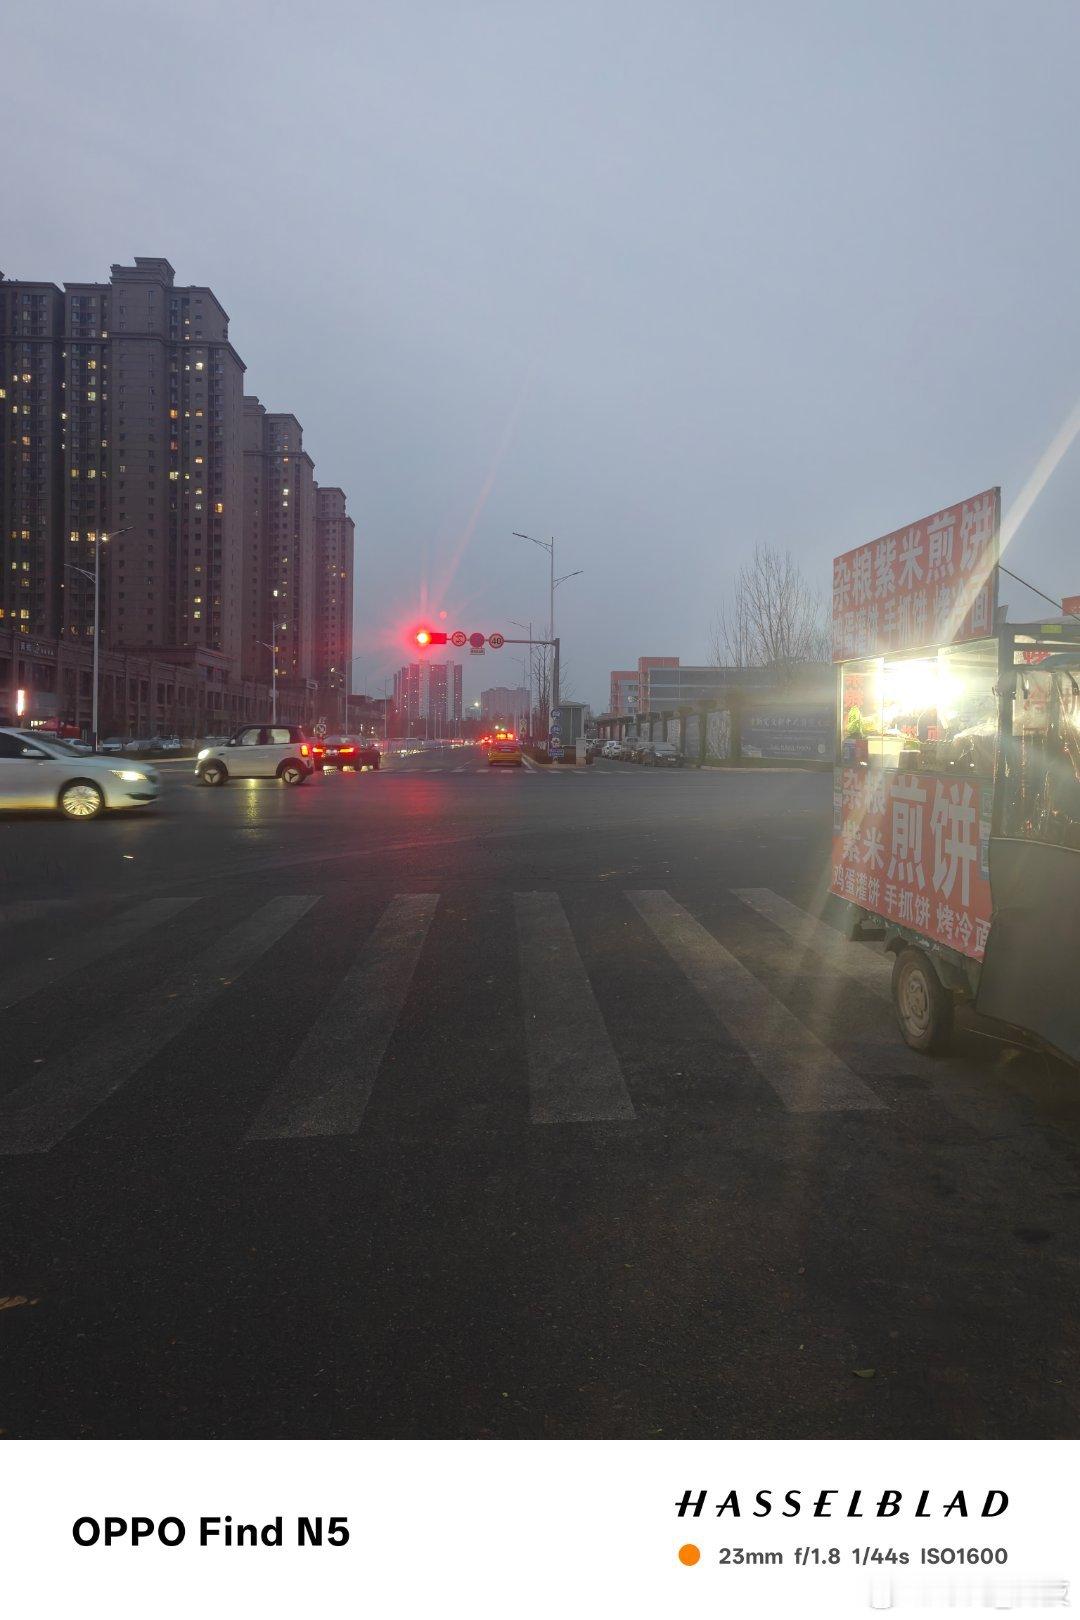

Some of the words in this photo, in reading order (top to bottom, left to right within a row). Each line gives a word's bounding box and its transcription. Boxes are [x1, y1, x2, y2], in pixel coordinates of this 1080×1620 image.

[833, 495, 993, 611] 杂粮紫米煎饼
[491, 637, 502, 645] 40
[842, 820, 885, 870] 紫米
[888, 775, 977, 907] 煎饼
[834, 864, 881, 908] 鸡蛋灌饼
[884, 884, 931, 930] 手抓饼
[936, 902, 992, 953] 烤冷面
